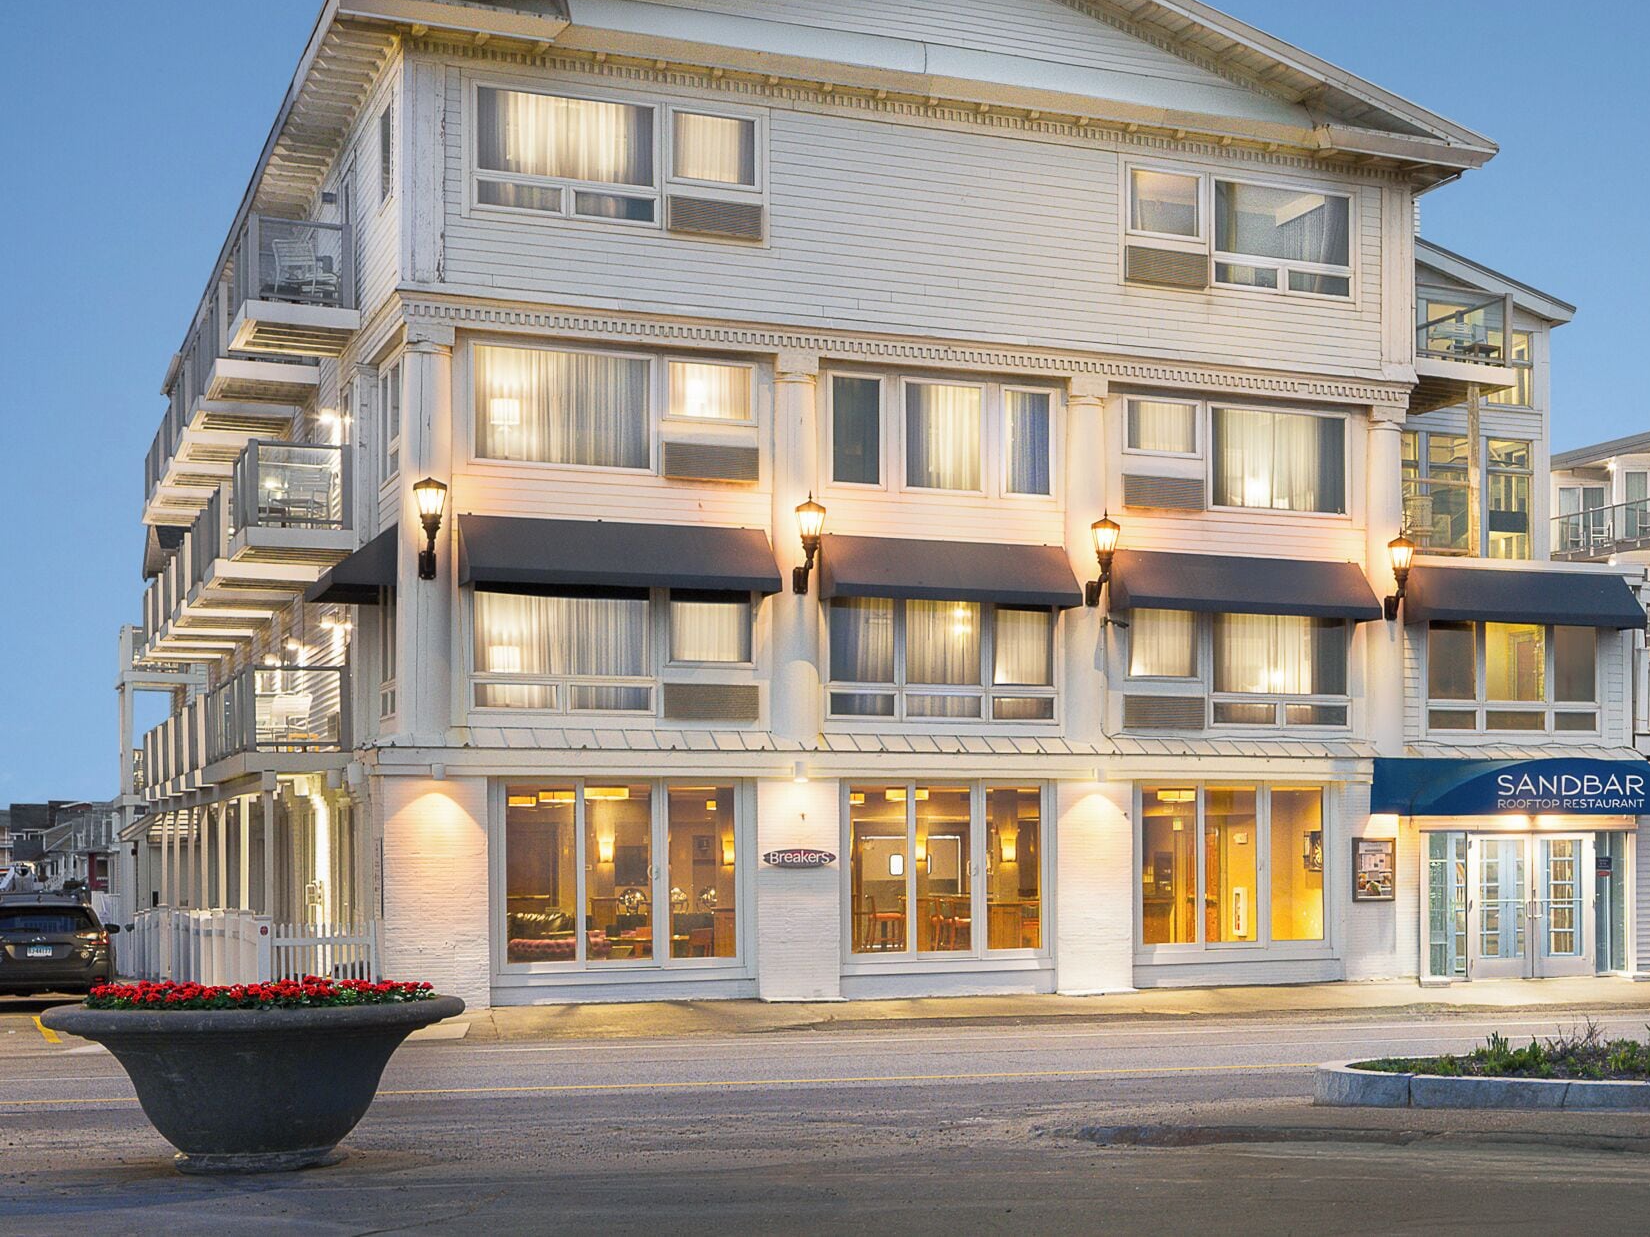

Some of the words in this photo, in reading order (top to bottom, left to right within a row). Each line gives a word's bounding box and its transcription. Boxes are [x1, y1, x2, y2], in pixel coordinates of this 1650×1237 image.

[1497, 773, 1646, 796] SANDBAR
[1497, 798, 1560, 809] ROOFTOP
[1563, 798, 1645, 809] RESTAURANT
[769, 849, 830, 864] Breakers
